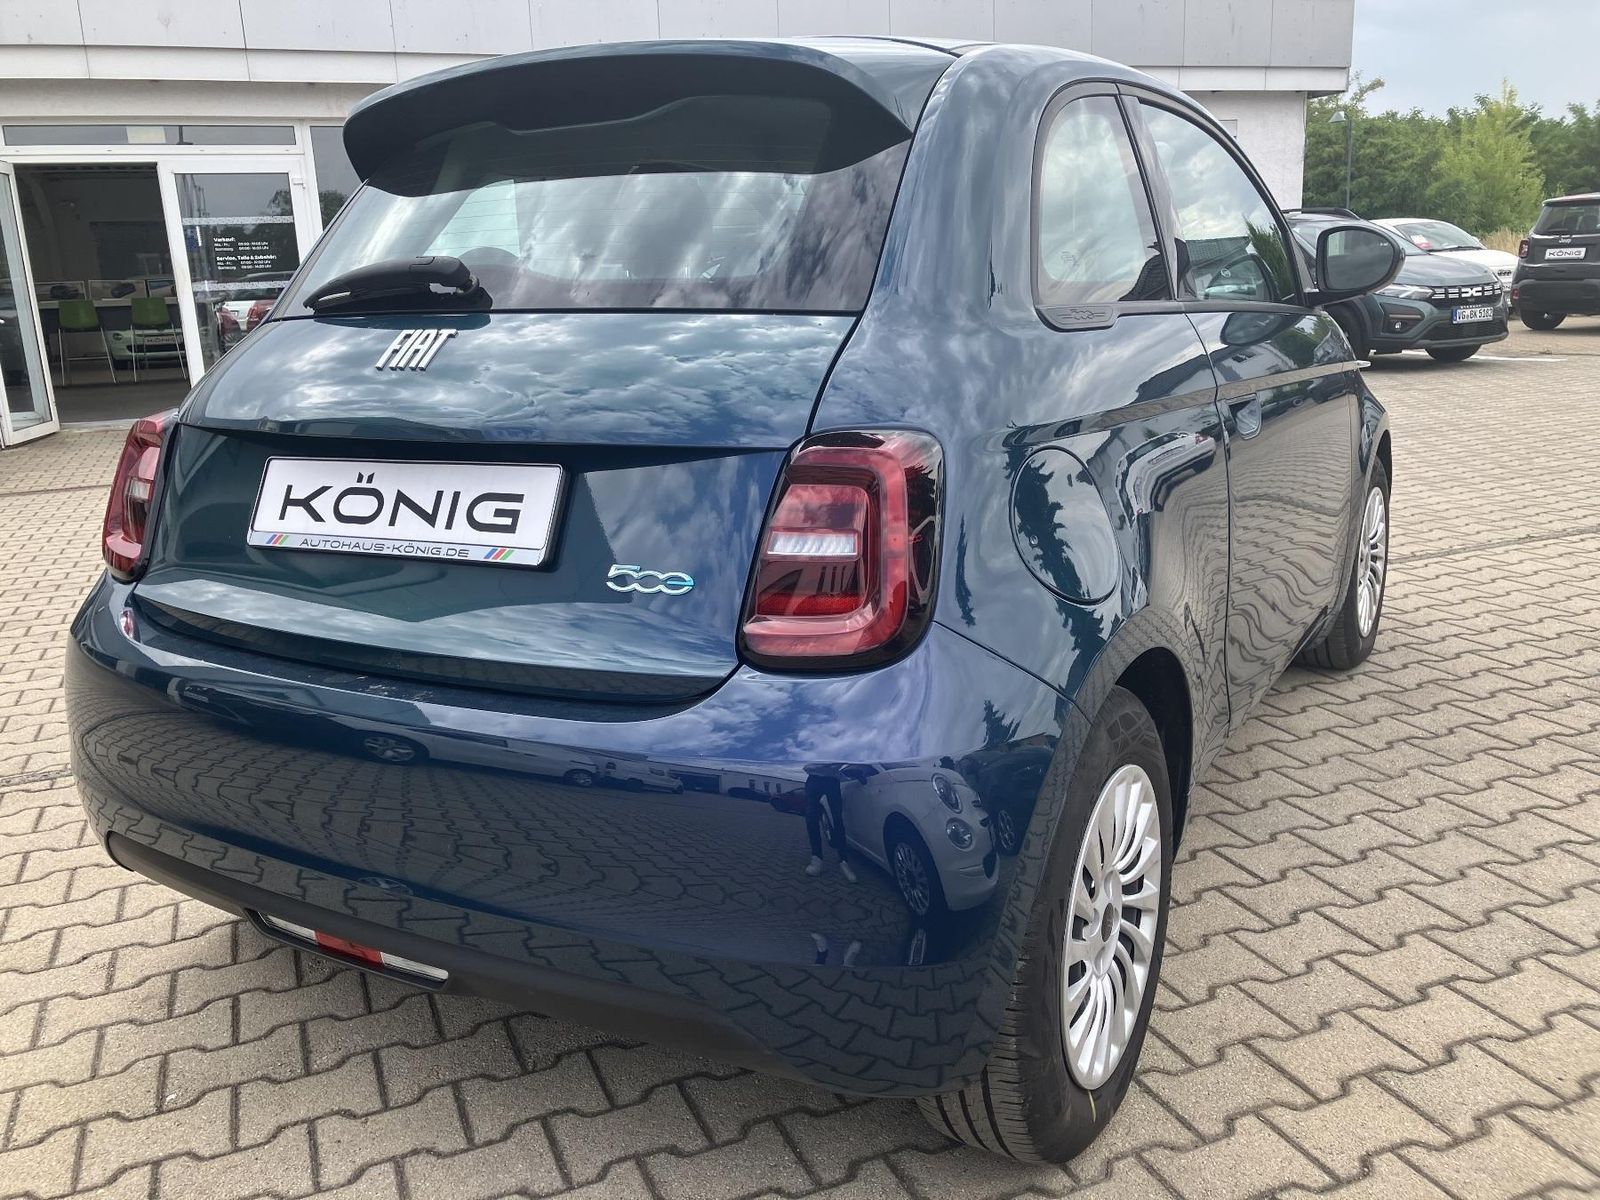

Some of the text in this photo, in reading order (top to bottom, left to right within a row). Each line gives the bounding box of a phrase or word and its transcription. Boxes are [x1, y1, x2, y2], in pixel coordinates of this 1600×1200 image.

[375, 329, 458, 371] FIAT
[278, 471, 525, 534] KÖNIG
[298, 537, 470, 558] AUTOHAUS-KÖNIG.DE
